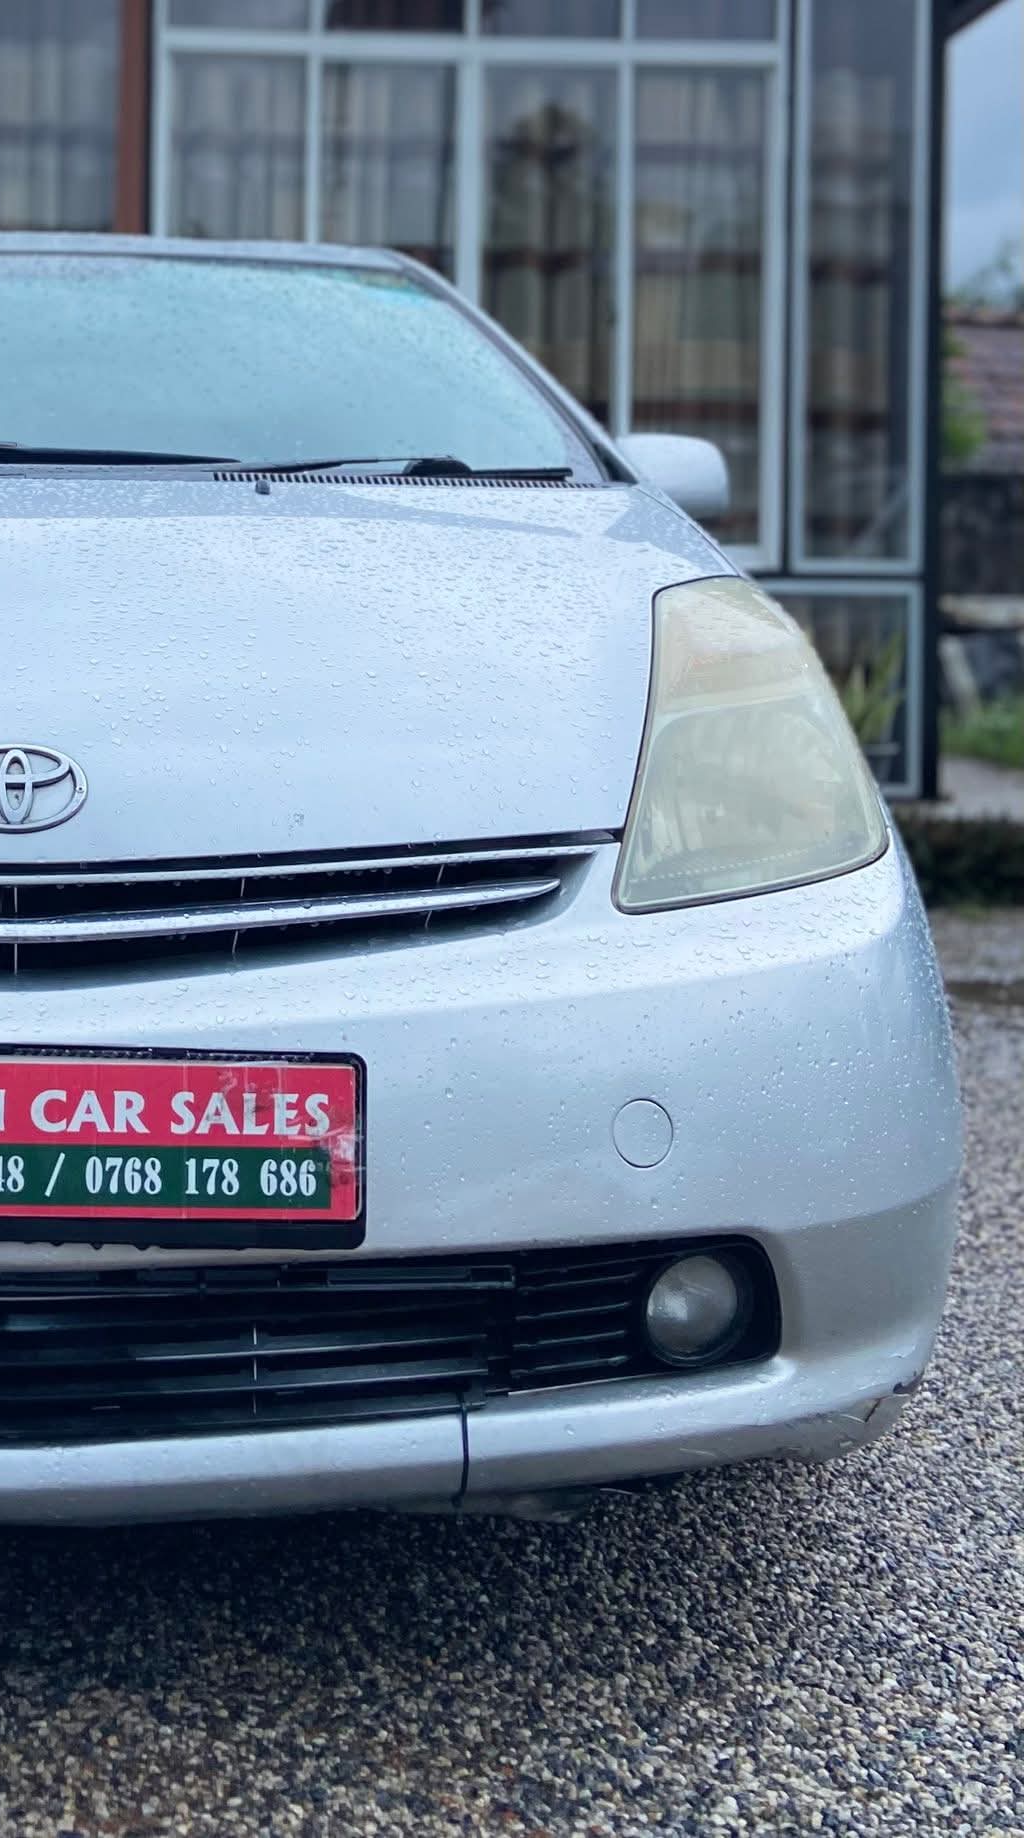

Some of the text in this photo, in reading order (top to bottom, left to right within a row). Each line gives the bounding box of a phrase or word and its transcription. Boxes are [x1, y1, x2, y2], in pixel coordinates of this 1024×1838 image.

[30, 1089, 150, 1134] CAR
[170, 1091, 330, 1137] SALES
[44, 1152, 66, 1198] /
[85, 1156, 162, 1195] 0768
[184, 1158, 240, 1196] 178
[260, 1158, 317, 1197] 686
